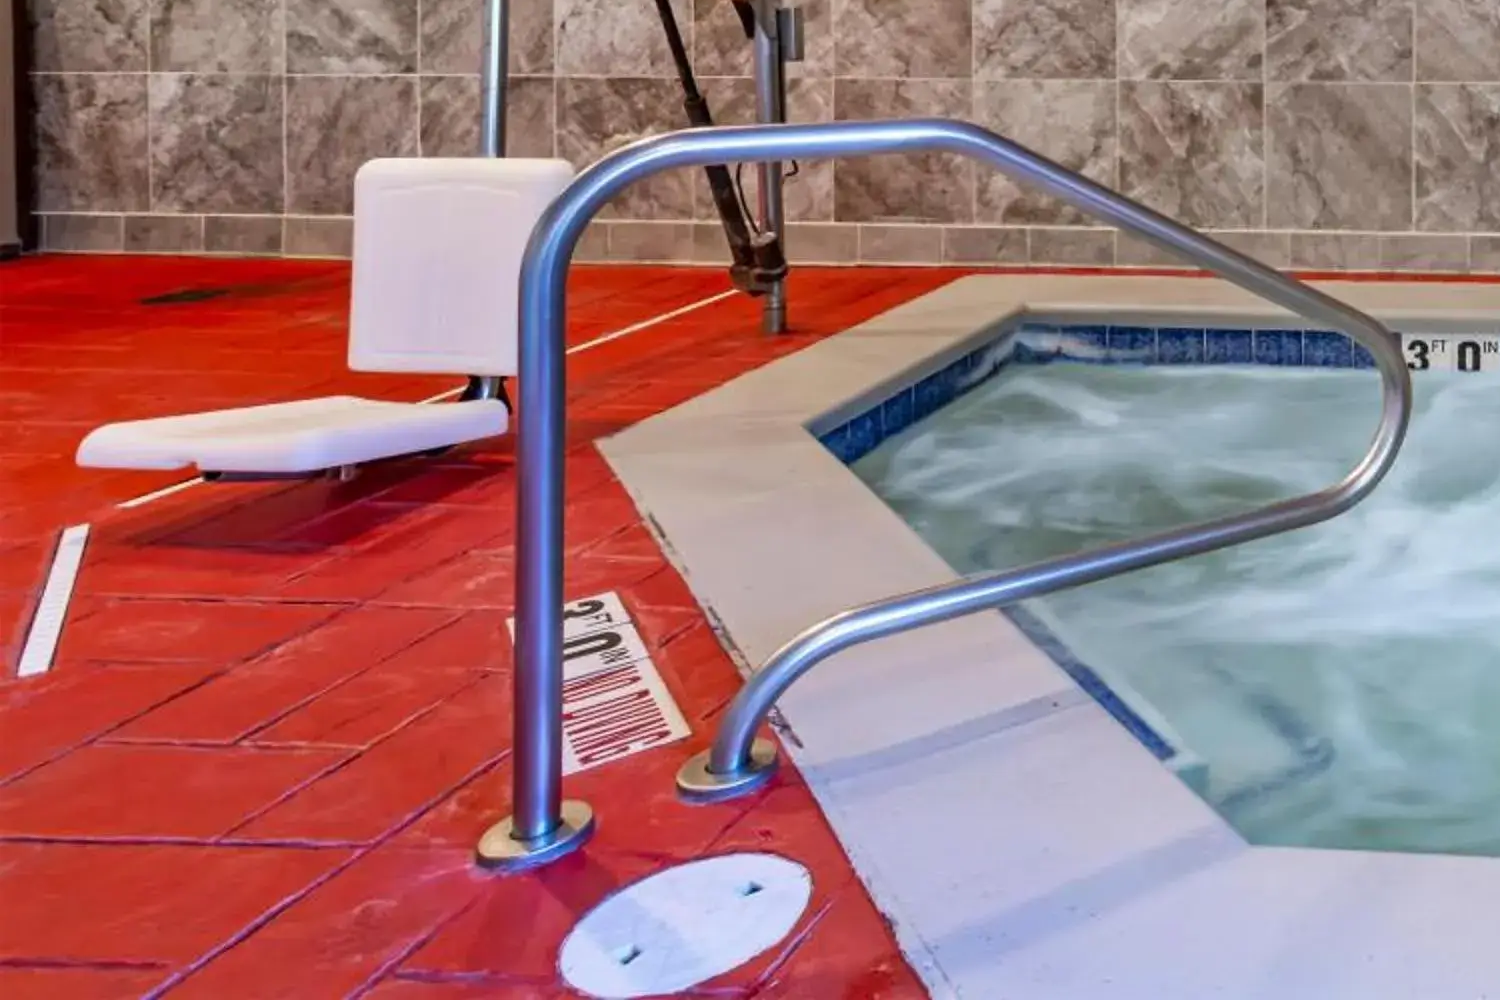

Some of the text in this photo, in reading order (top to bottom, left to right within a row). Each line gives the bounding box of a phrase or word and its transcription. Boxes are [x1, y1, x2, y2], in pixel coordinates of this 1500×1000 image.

[1407, 339, 1499, 372] 3 FT 0 IN
[562, 665, 643, 704] NO
[561, 688, 672, 765] DIVING
